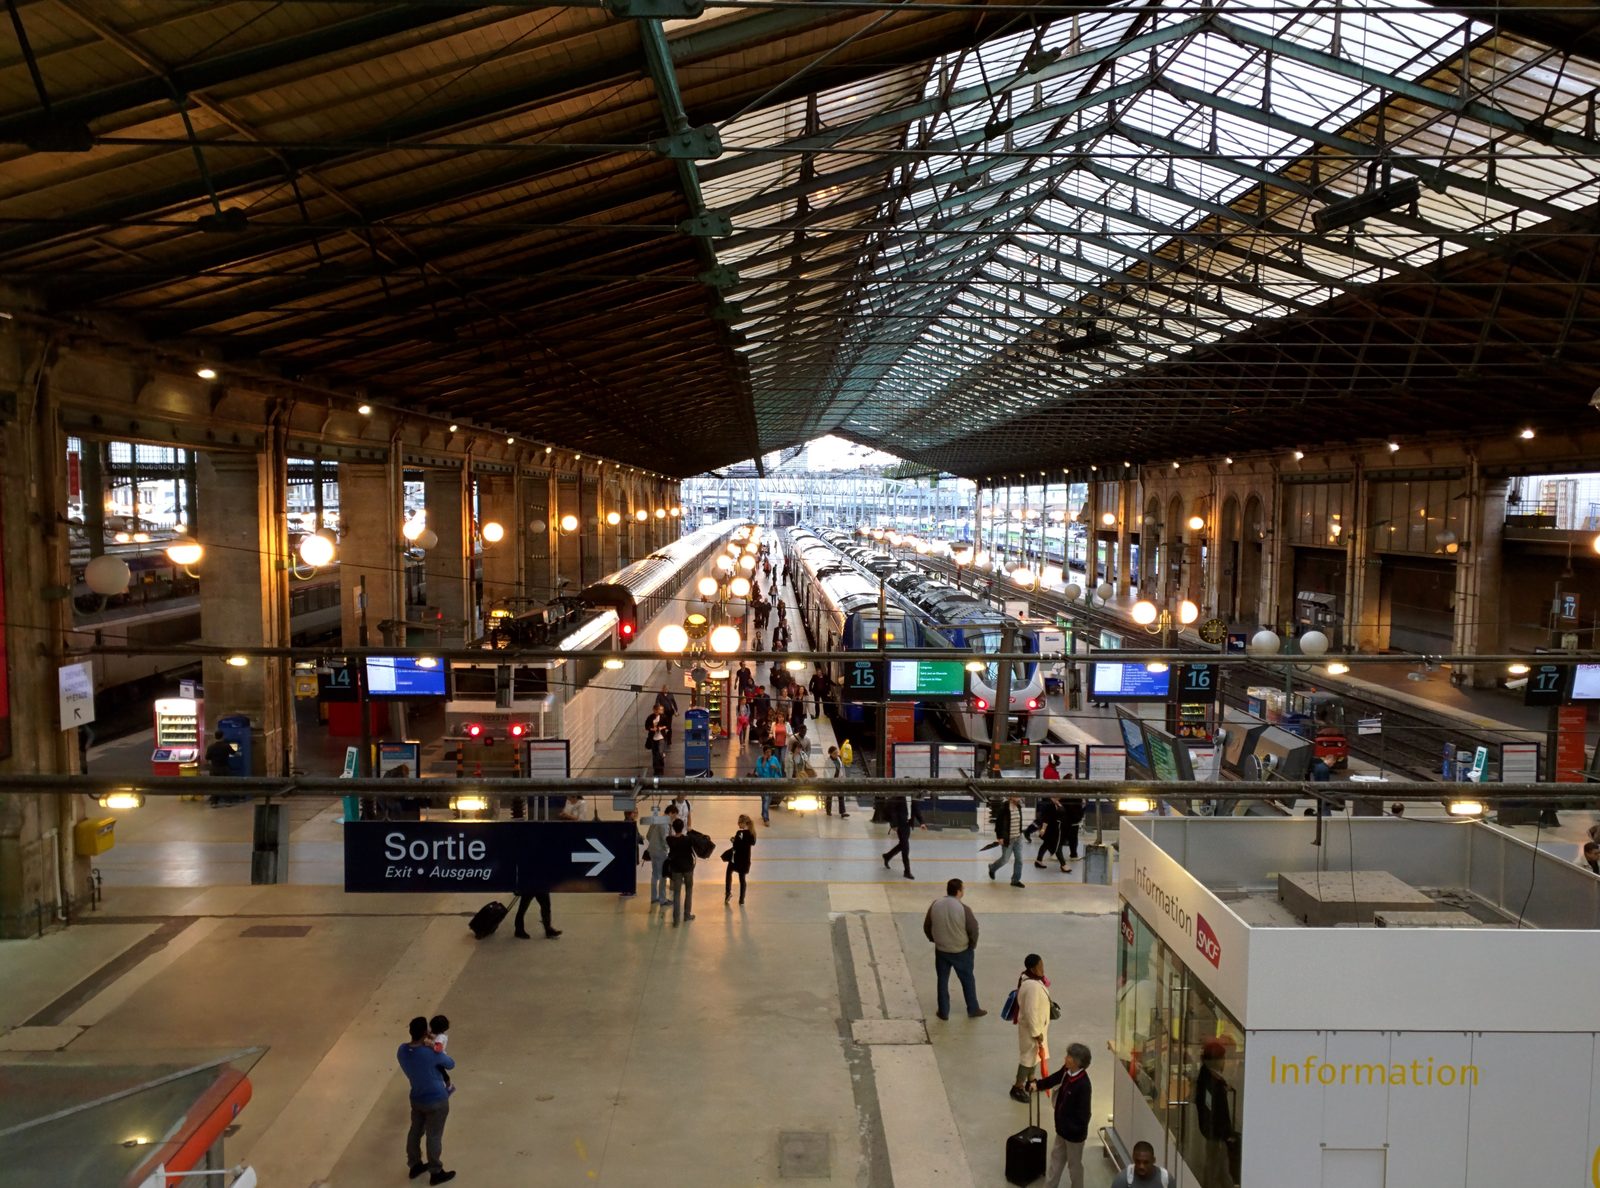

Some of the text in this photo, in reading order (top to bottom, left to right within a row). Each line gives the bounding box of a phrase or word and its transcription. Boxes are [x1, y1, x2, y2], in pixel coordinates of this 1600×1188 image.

[1564, 602, 1576, 617] 17
[329, 668, 351, 686] 14
[851, 669, 875, 686] 15
[1187, 671, 1211, 687] 16
[1536, 673, 1559, 689] 17
[384, 832, 487, 861] Sortie
[384, 866, 492, 880] Exit Ausgang
[1133, 857, 1193, 937] Information
[1197, 929, 1220, 961] SNCF
[1270, 1055, 1480, 1087] Information
